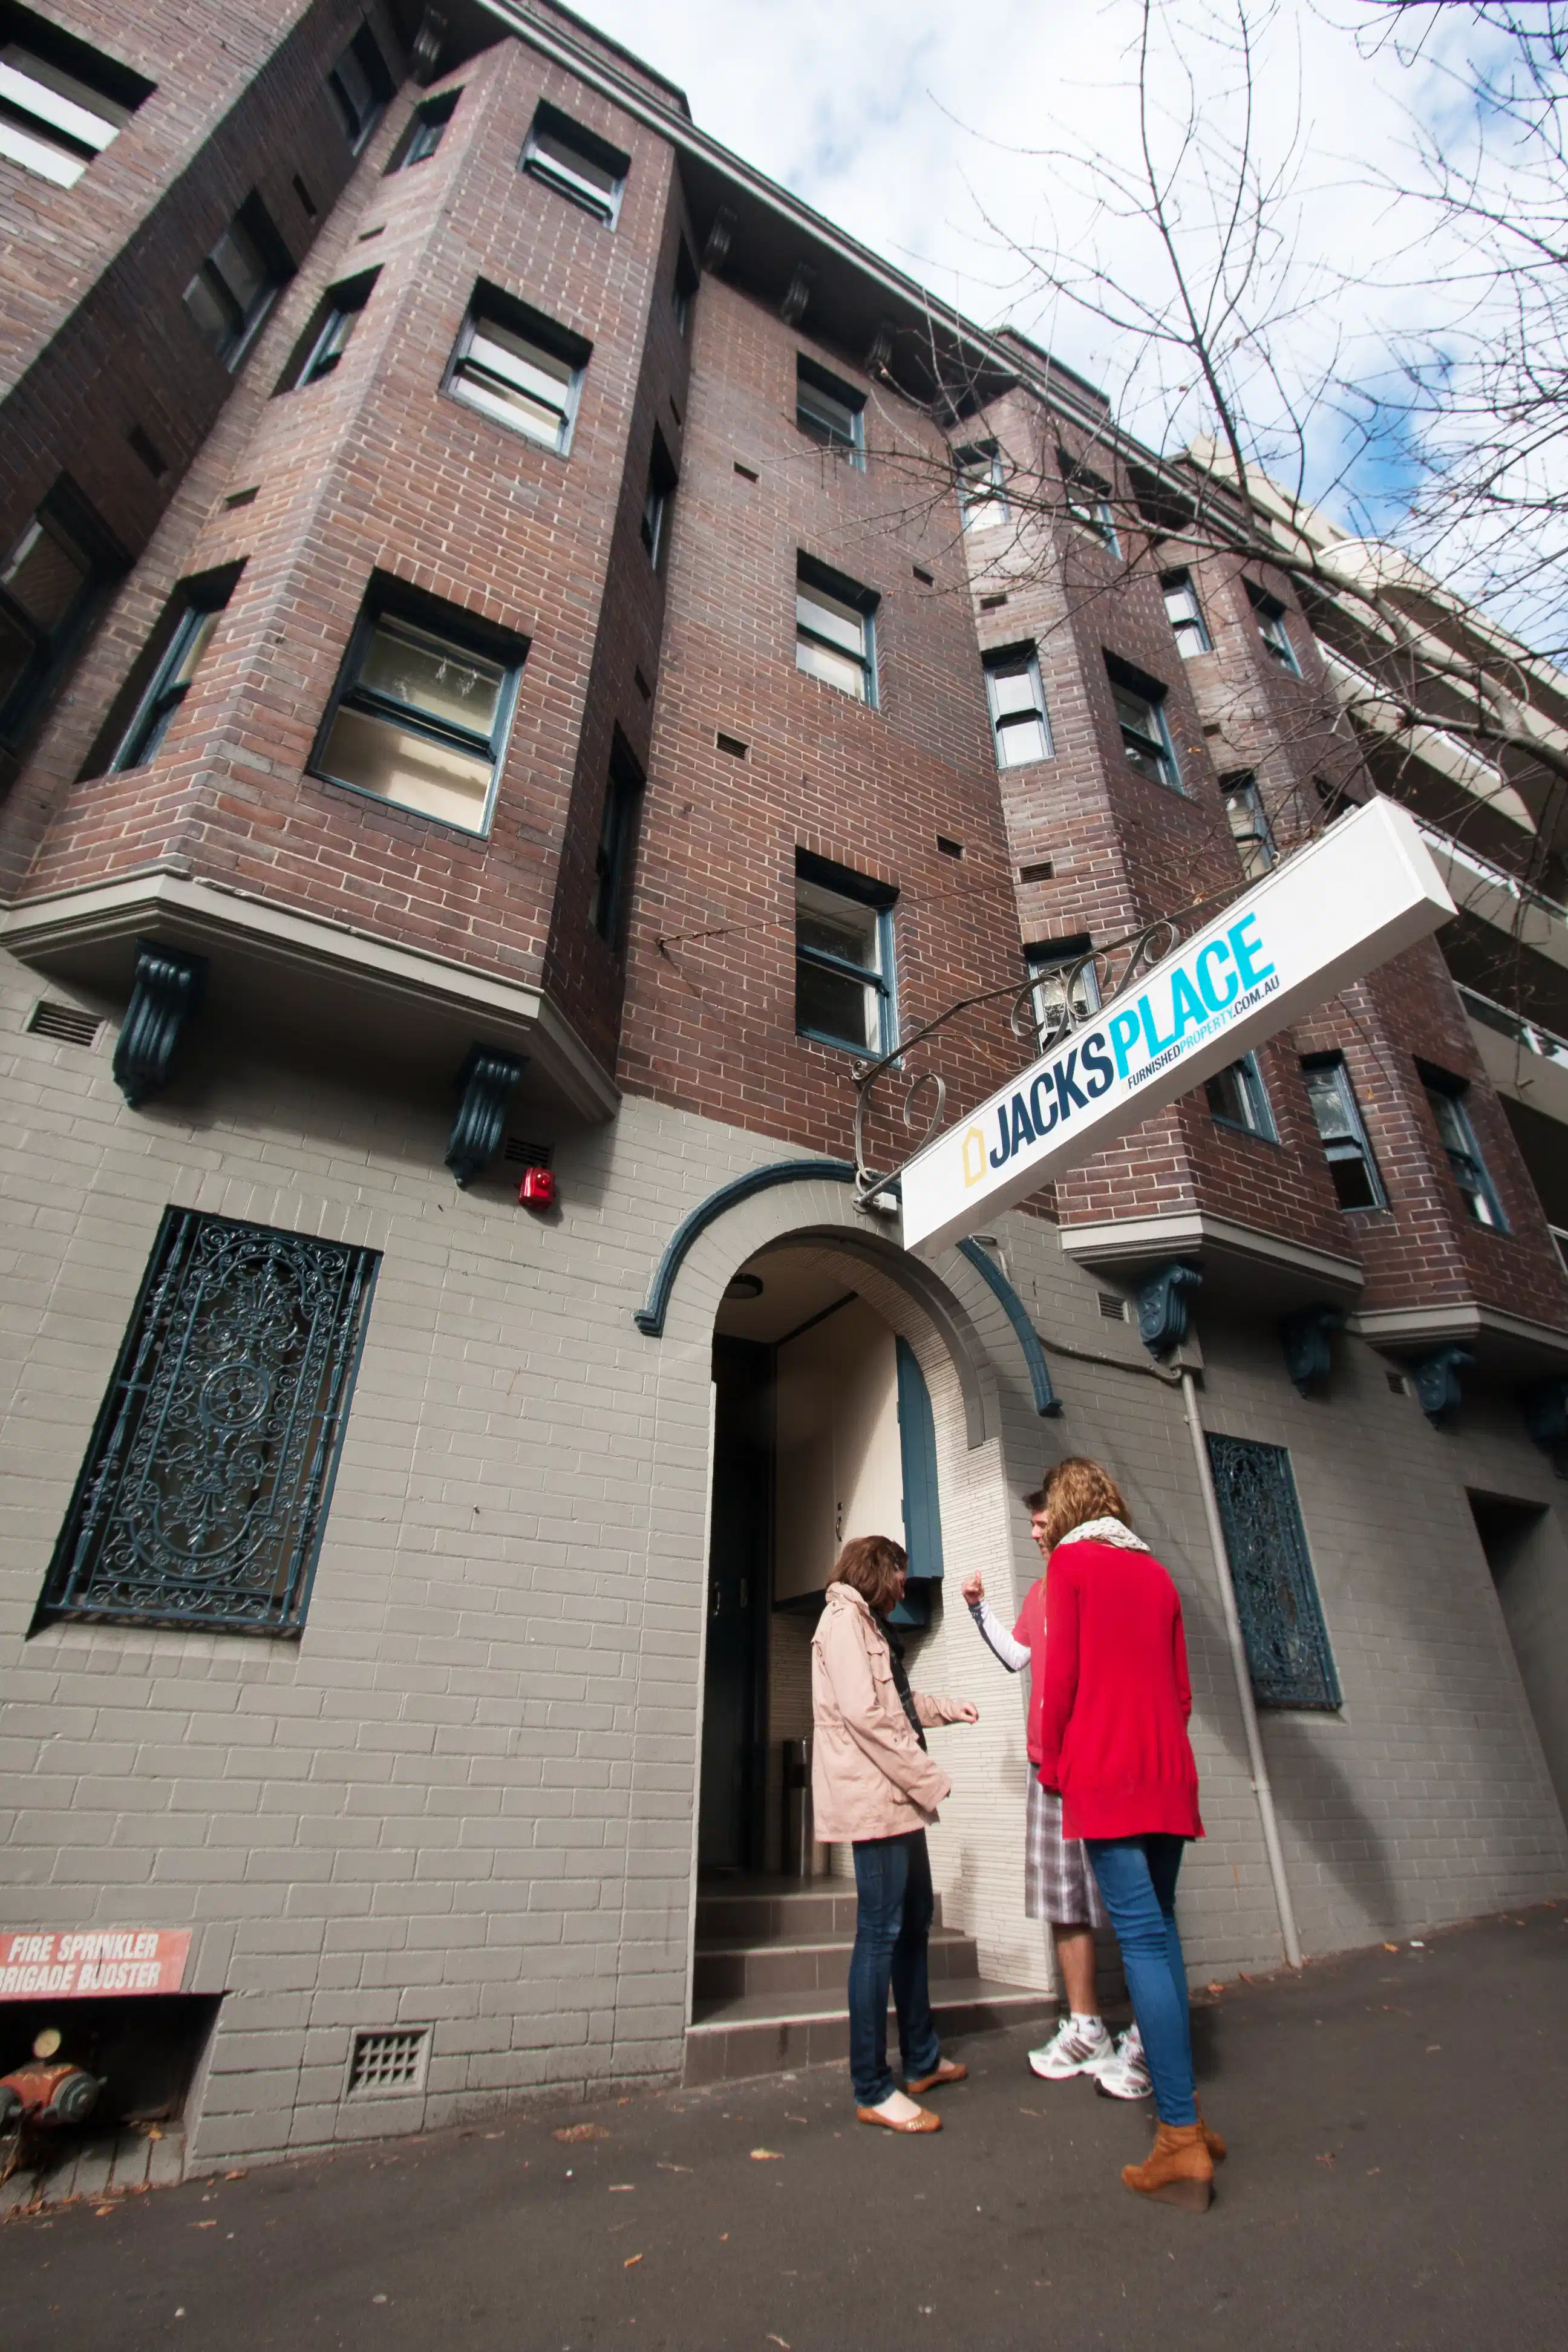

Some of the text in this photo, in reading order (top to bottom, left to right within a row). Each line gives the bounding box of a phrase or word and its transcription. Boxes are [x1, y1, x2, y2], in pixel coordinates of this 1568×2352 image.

[1128, 975, 1279, 1089] FURNISHEDPROPERTY.COM.AU
[7, 1933, 160, 1962] FIRE SPRINKLER
[77, 1962, 161, 1989] BOOSTER
